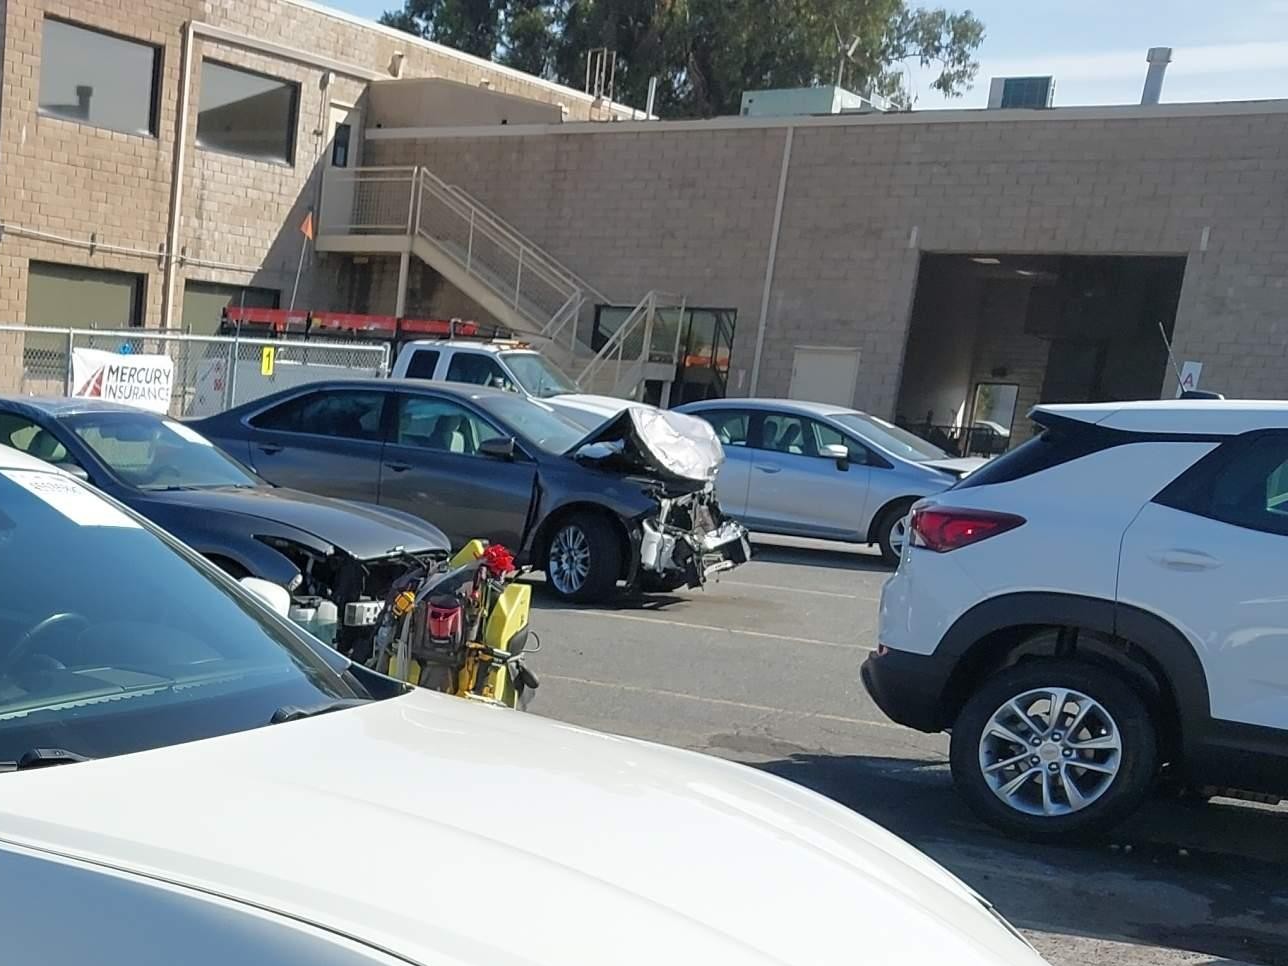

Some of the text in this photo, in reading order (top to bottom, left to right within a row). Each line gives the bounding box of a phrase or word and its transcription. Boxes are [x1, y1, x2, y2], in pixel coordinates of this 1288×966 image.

[265, 350, 272, 371] 1
[107, 364, 171, 386] MERCURY
[1182, 373, 1195, 388] A
